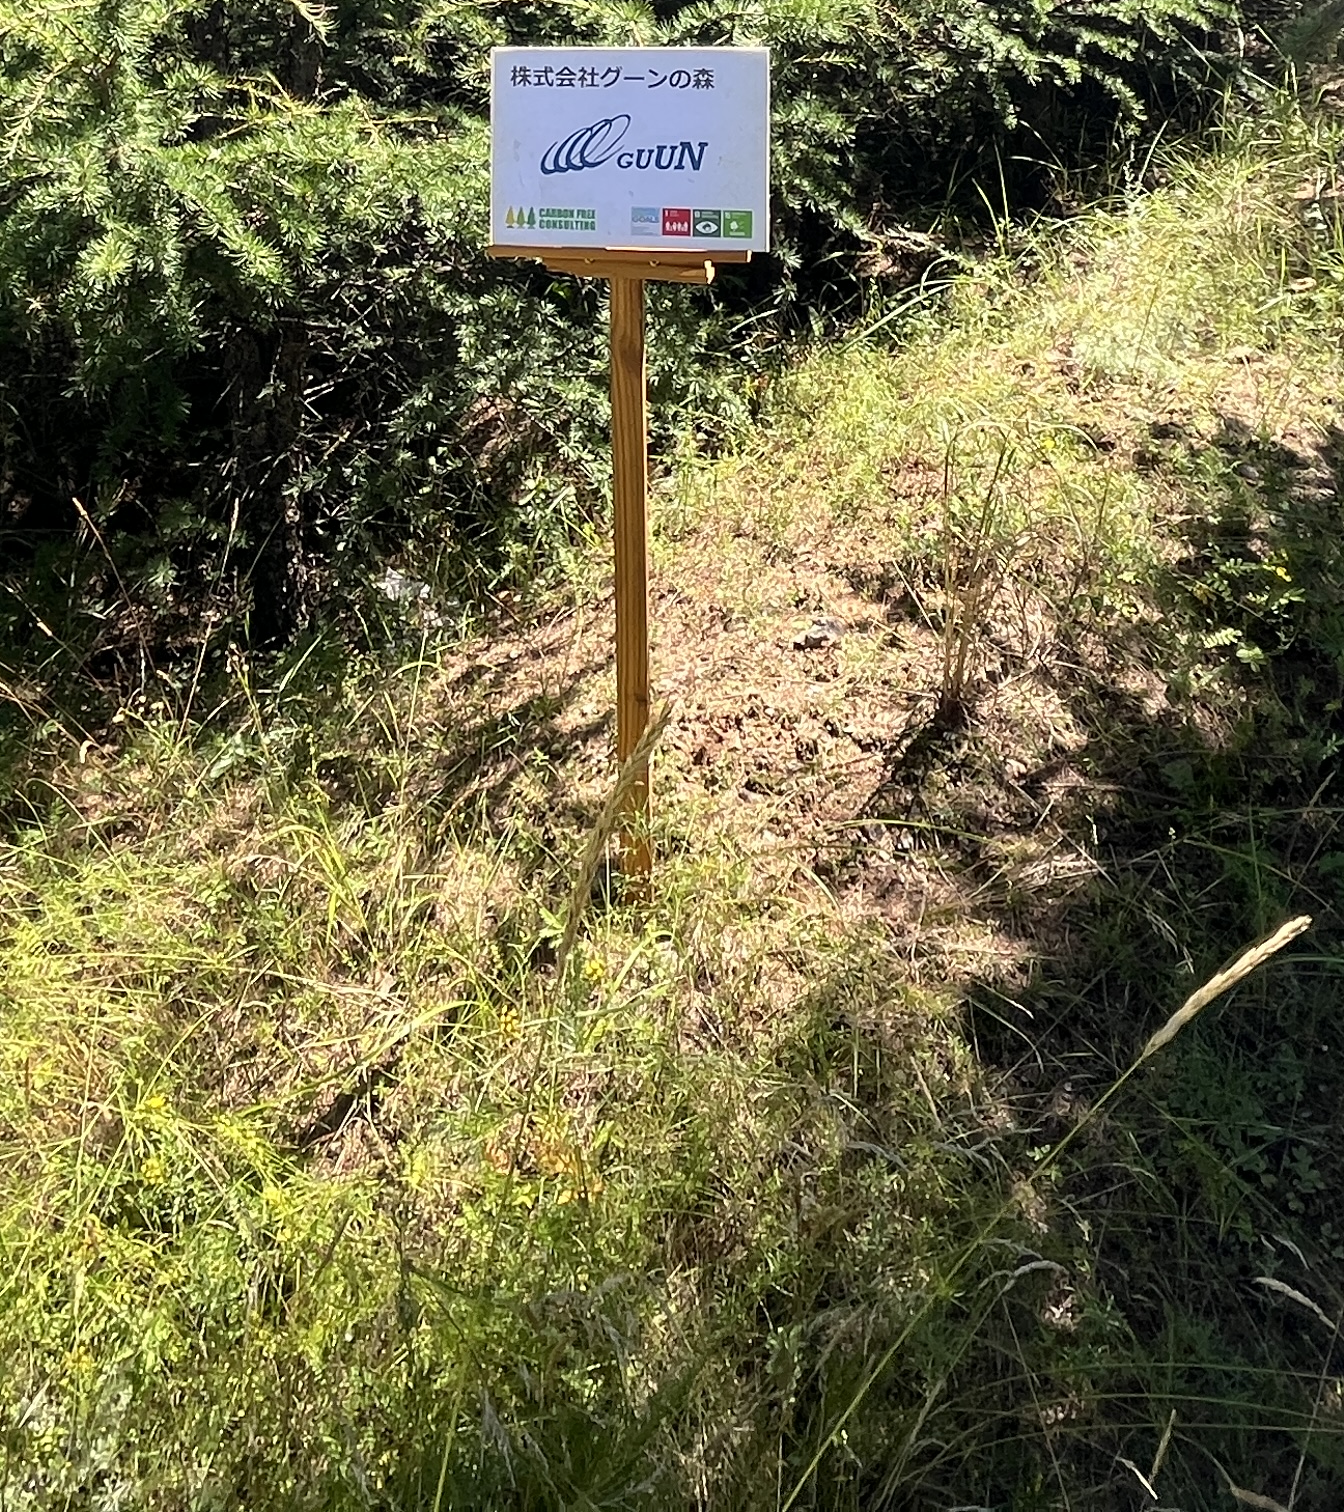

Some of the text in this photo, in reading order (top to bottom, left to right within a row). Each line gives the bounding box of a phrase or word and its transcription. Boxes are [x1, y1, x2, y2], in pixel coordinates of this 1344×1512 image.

[510, 65, 715, 90] 株式会社グーンの森
[617, 141, 709, 171] GUUN
[539, 208, 596, 219] CARBON FREE
[539, 219, 596, 231] CONSULTING
